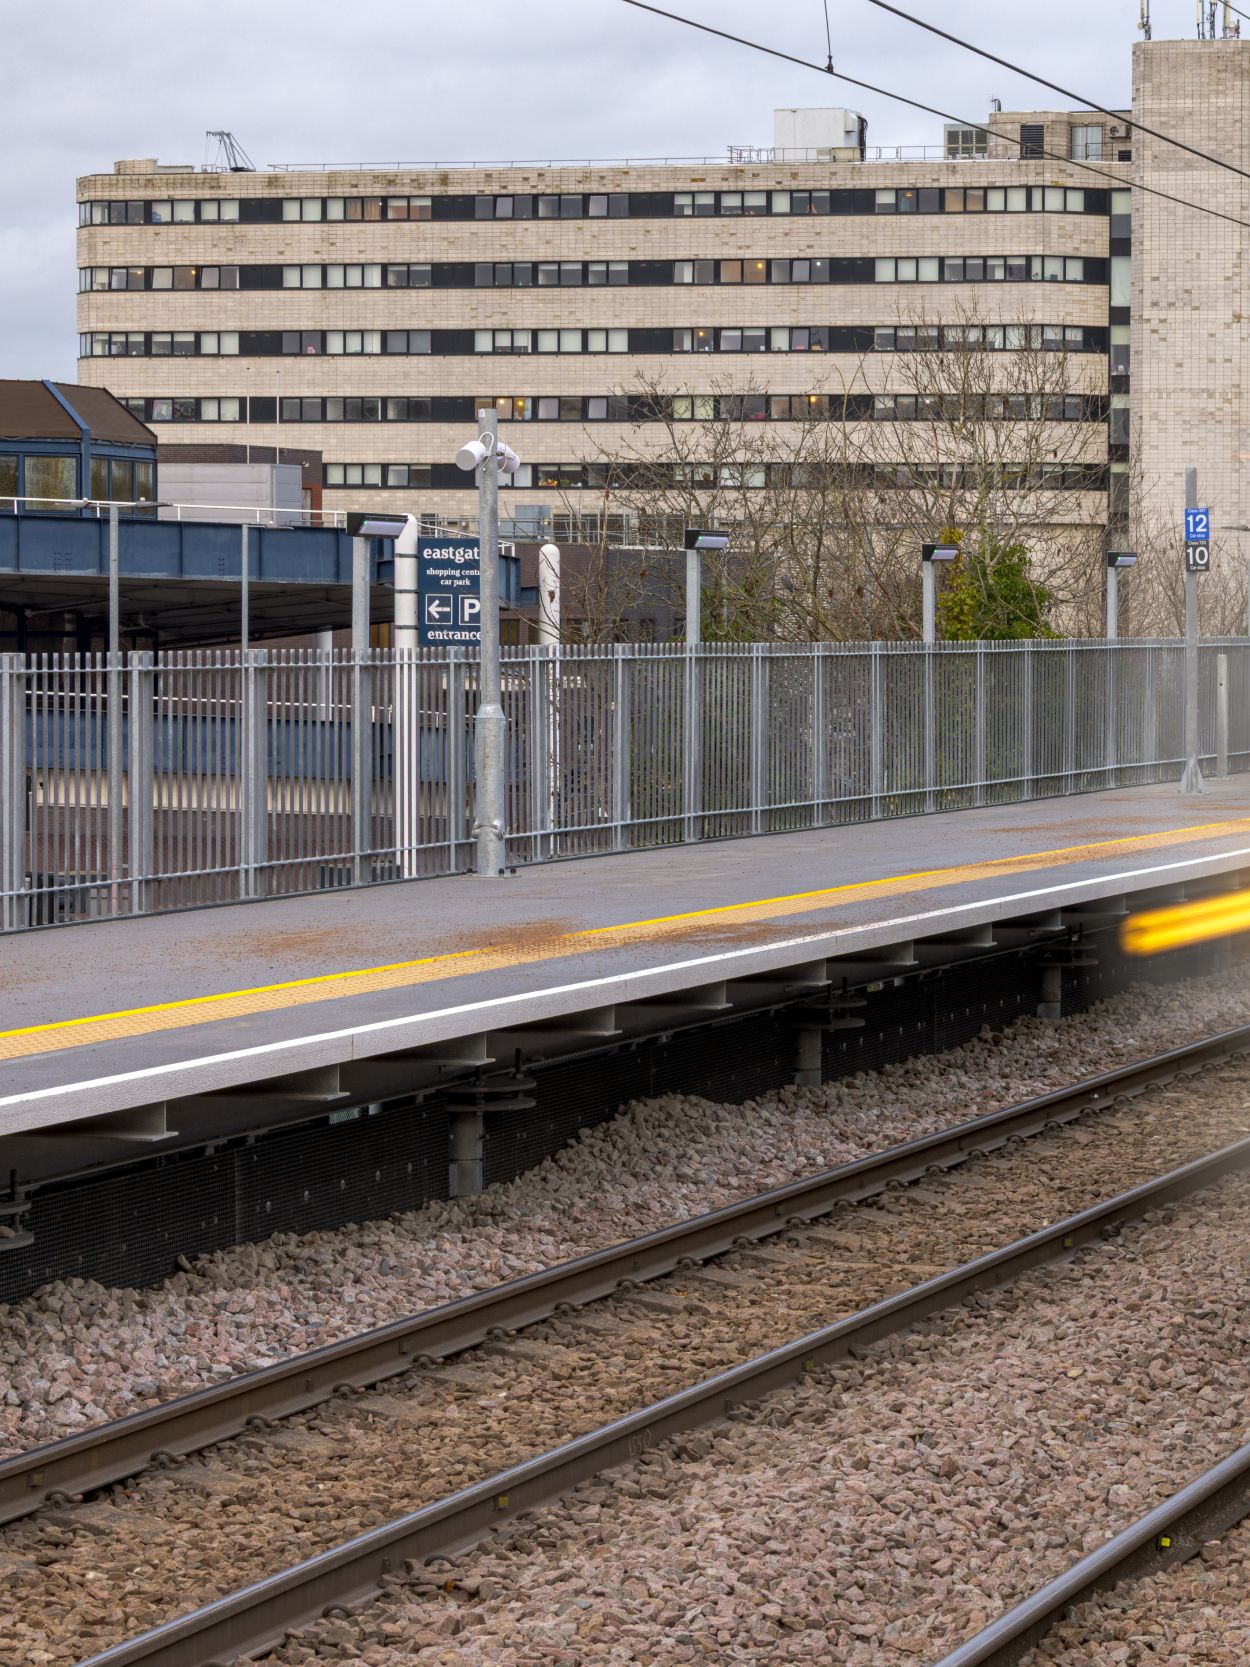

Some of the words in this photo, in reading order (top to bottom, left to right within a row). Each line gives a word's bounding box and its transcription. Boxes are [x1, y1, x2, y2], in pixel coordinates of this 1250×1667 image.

[1187, 515, 1207, 532] 12
[423, 547, 480, 563] eastgat
[1187, 546, 1208, 564] 10
[426, 568, 461, 577] shopping
[453, 578, 471, 587] park
[464, 598, 480, 622] P
[427, 629, 482, 641] entrance
